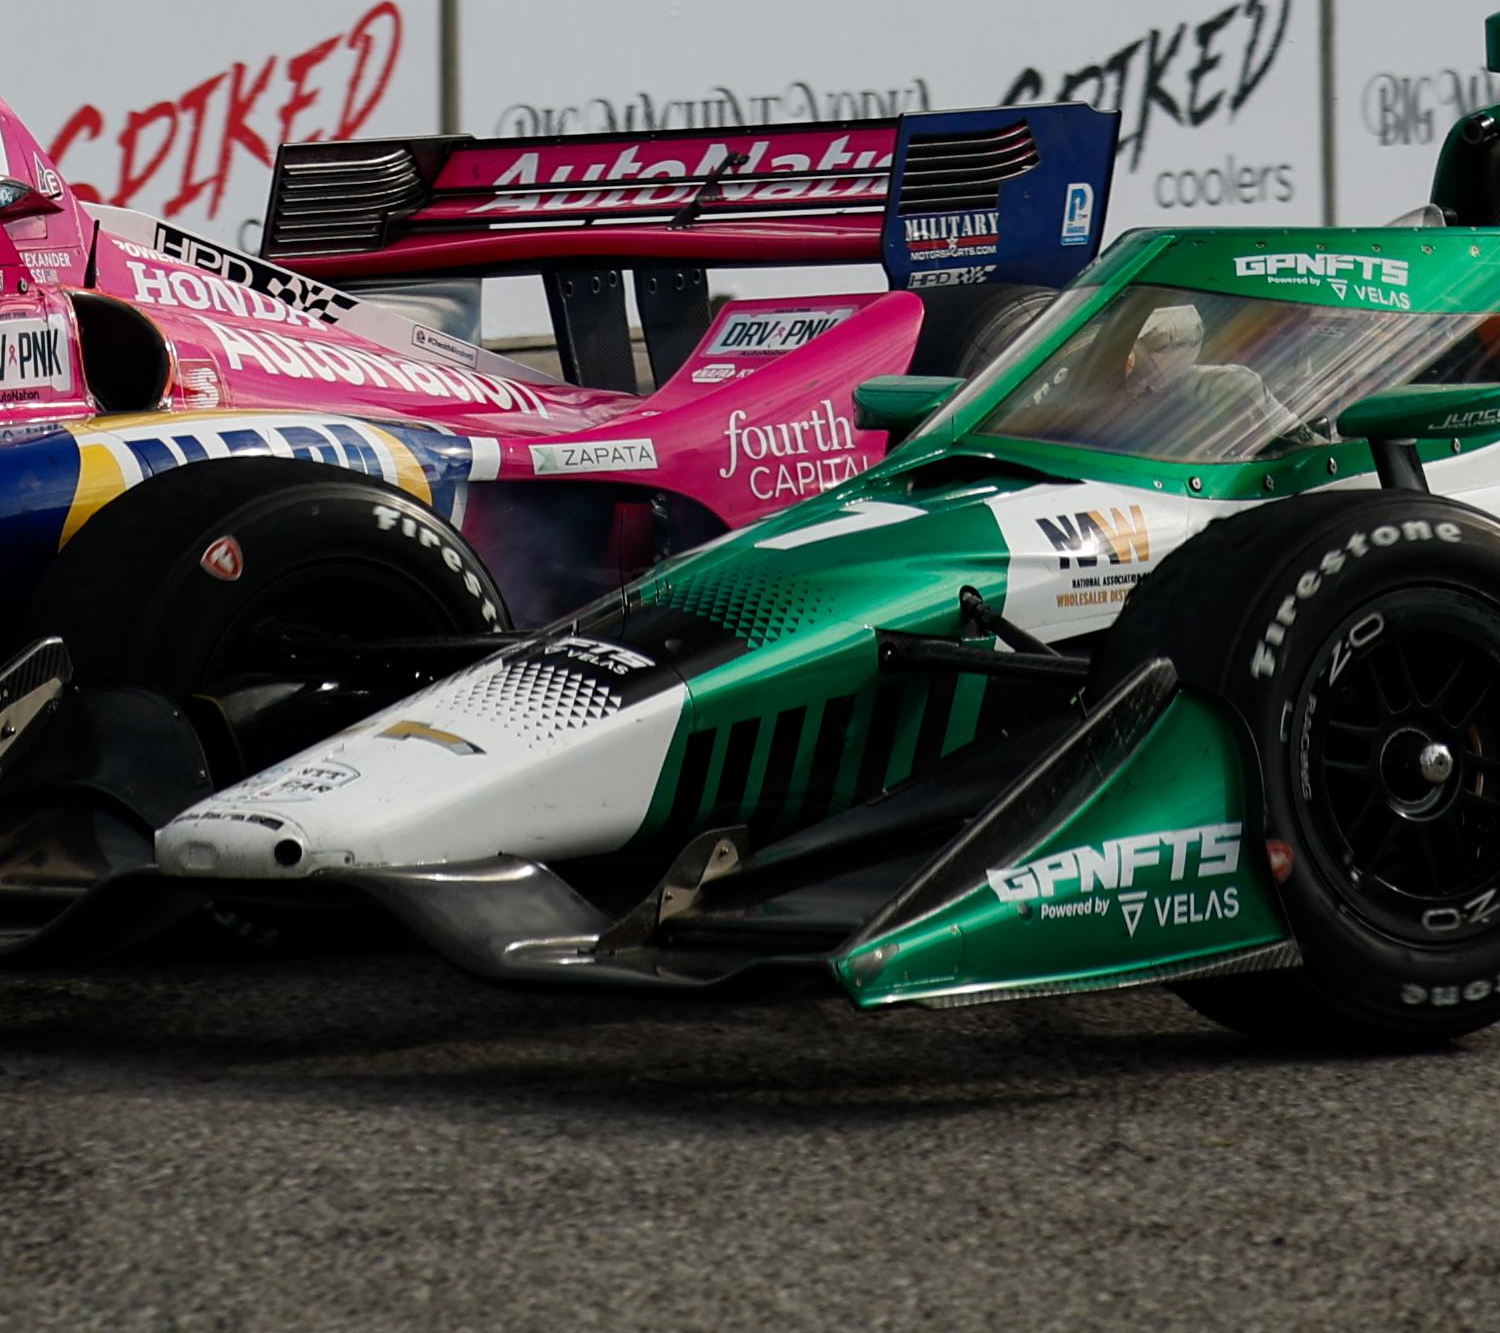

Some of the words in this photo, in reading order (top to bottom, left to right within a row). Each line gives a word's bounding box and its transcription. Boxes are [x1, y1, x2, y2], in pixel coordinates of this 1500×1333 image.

[48, 0, 402, 221] SPIKED
[1365, 70, 1434, 146] BIG
[1155, 154, 1294, 209] coolers
[904, 212, 1000, 242] MILITARY
[1233, 253, 1409, 286] GPNFTS
[1267, 276, 1308, 285] Powered
[1310, 276, 1321, 287] by
[1353, 284, 1411, 310] VELAS
[20, 329, 63, 380] PNK
[202, 315, 553, 420] AutoNation
[564, 445, 653, 467] ZAPATA
[719, 399, 856, 478] fourth
[1056, 590, 1108, 609] WHOLESALER
[1072, 576, 1101, 589] NATIONAL
[1251, 516, 1463, 681] Firestone
[986, 822, 1242, 902] GPNFTS
[1041, 900, 1092, 920] Powered
[1094, 898, 1110, 917] by
[1154, 886, 1240, 927] VELAS
